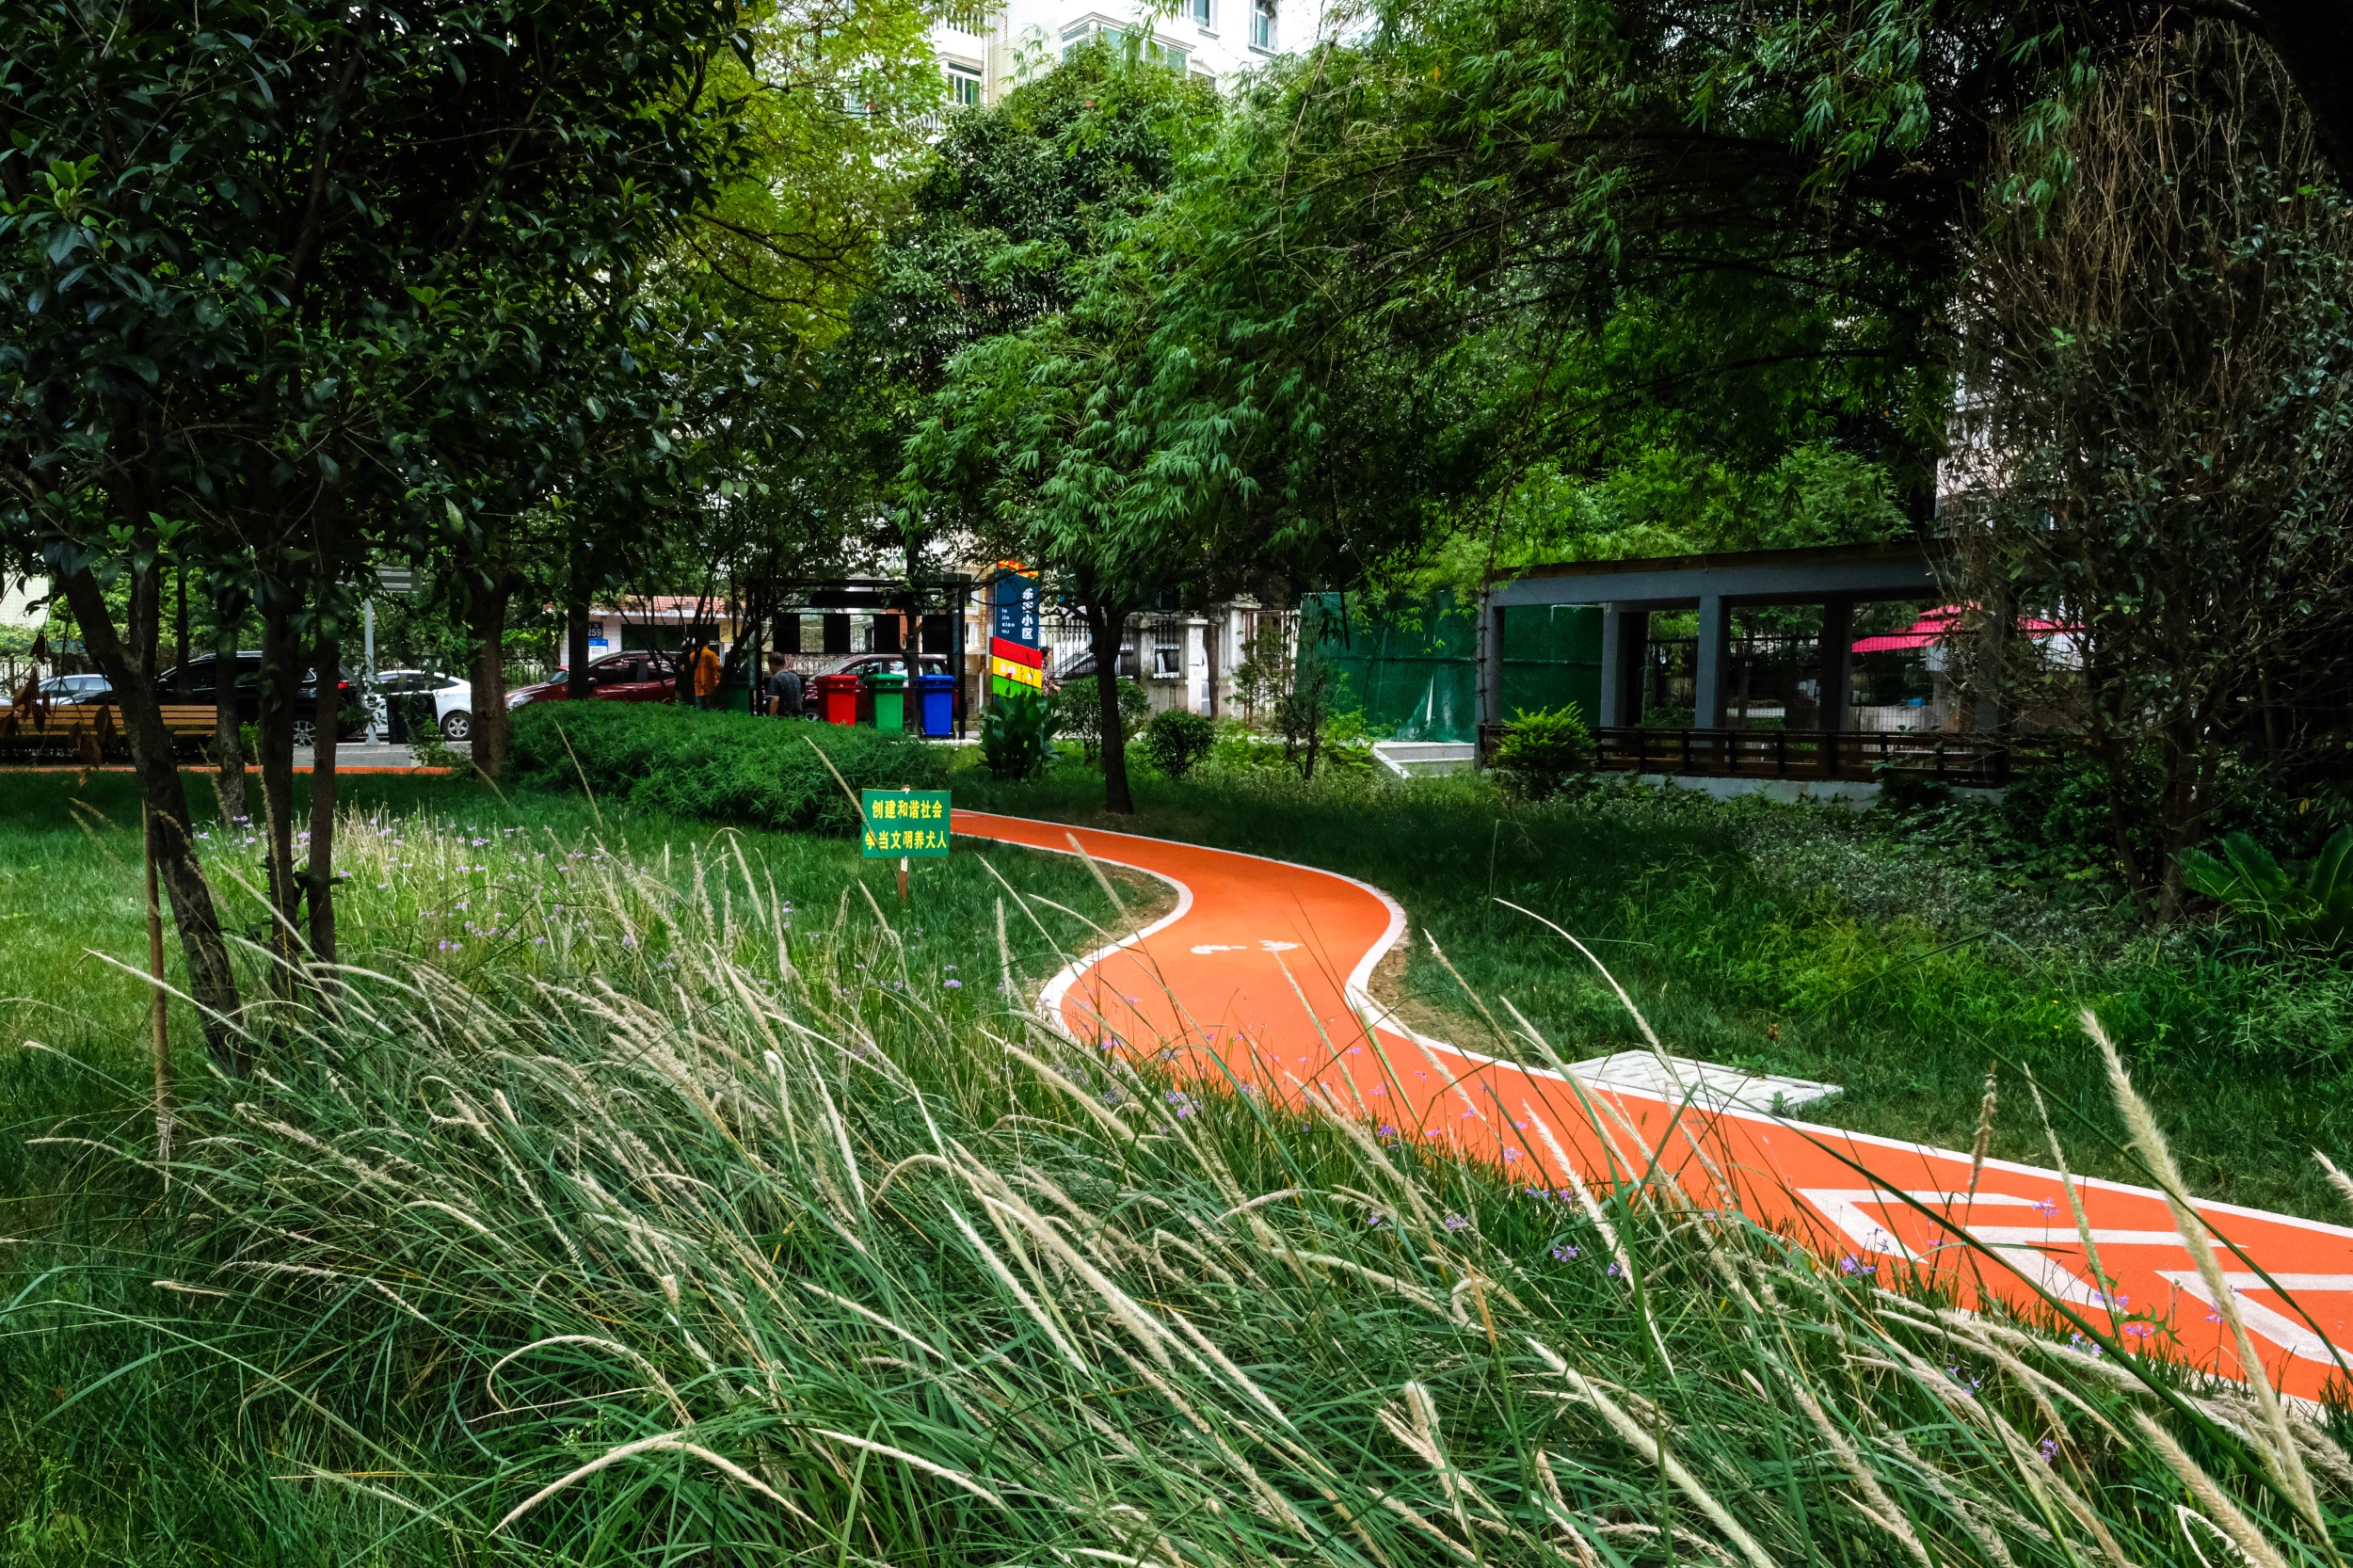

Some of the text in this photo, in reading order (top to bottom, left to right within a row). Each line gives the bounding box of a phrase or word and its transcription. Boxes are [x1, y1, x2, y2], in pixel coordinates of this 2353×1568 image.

[872, 799, 943, 820] 创建和谐社会
[865, 830, 947, 850] 争当文明养犬人
